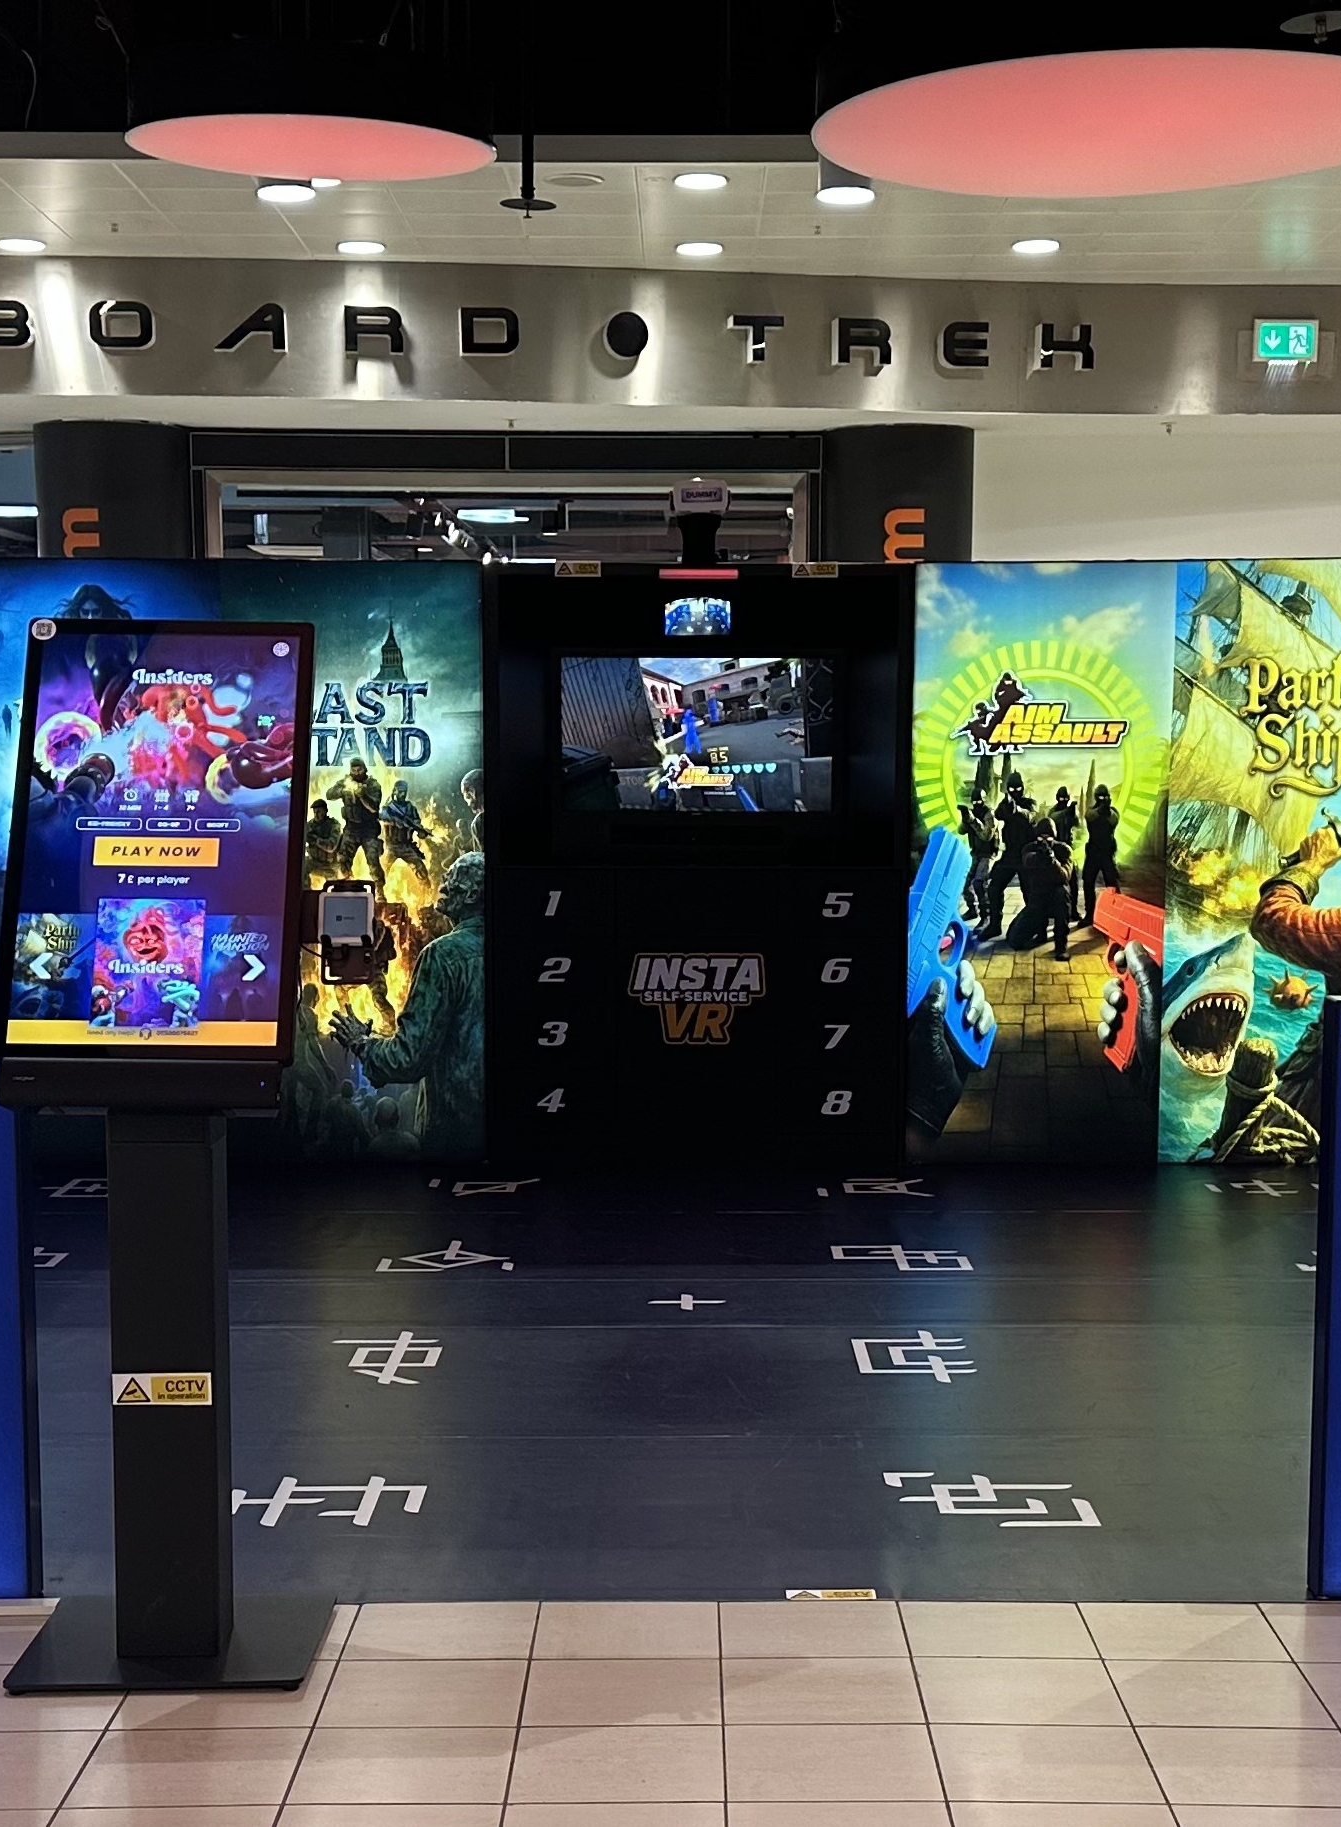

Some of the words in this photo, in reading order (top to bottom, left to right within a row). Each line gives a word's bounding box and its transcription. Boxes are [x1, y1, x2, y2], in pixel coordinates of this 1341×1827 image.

[731, 315, 1095, 371] TREK
[685, 489, 720, 500] DUMMY
[131, 668, 214, 685] Insiders
[312, 680, 429, 725] AST
[1001, 703, 1066, 725] AIM
[988, 723, 1125, 744] ASSAULT
[311, 726, 432, 768] TAND
[111, 845, 154, 857] PLAY
[158, 845, 202, 857] NOW
[137, 876, 156, 886] per
[156, 874, 191, 887] player
[544, 890, 562, 917] 1
[822, 892, 854, 918] 5
[106, 958, 185, 975] Insiders
[538, 957, 572, 983] 2
[633, 957, 761, 991] INSTA
[821, 958, 853, 984] 6
[643, 990, 748, 1003] SELF-SERVICE
[537, 1021, 569, 1047] 3
[664, 1003, 729, 1039] VR
[823, 1024, 851, 1050] 7
[537, 1087, 567, 1113] 4
[821, 1090, 853, 1115] 8
[157, 1392, 166, 1400] in
[166, 1392, 206, 1401] operation
[165, 1379, 206, 1393] CCTV
